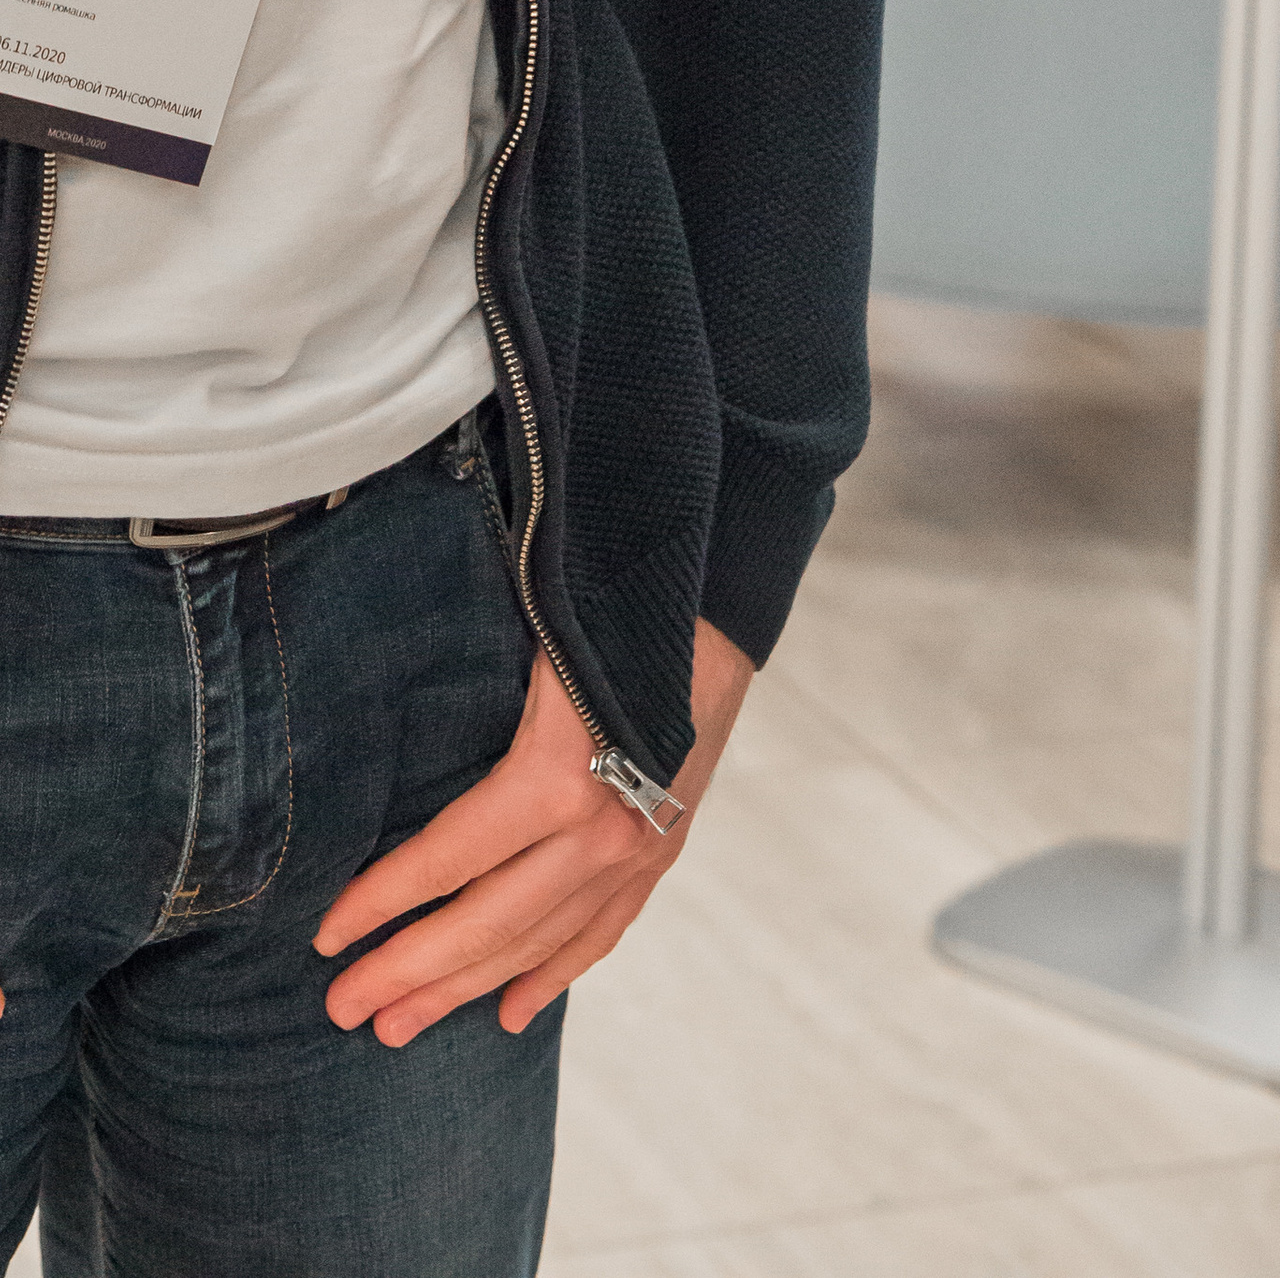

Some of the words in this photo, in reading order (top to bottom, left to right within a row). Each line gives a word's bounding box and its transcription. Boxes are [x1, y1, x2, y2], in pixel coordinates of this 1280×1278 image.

[52, 2, 96, 21] ромашка
[36, 69, 103, 98] ЦИФРОВОЙ
[104, 84, 203, 121] ТРАНСФОРМАЦИИ
